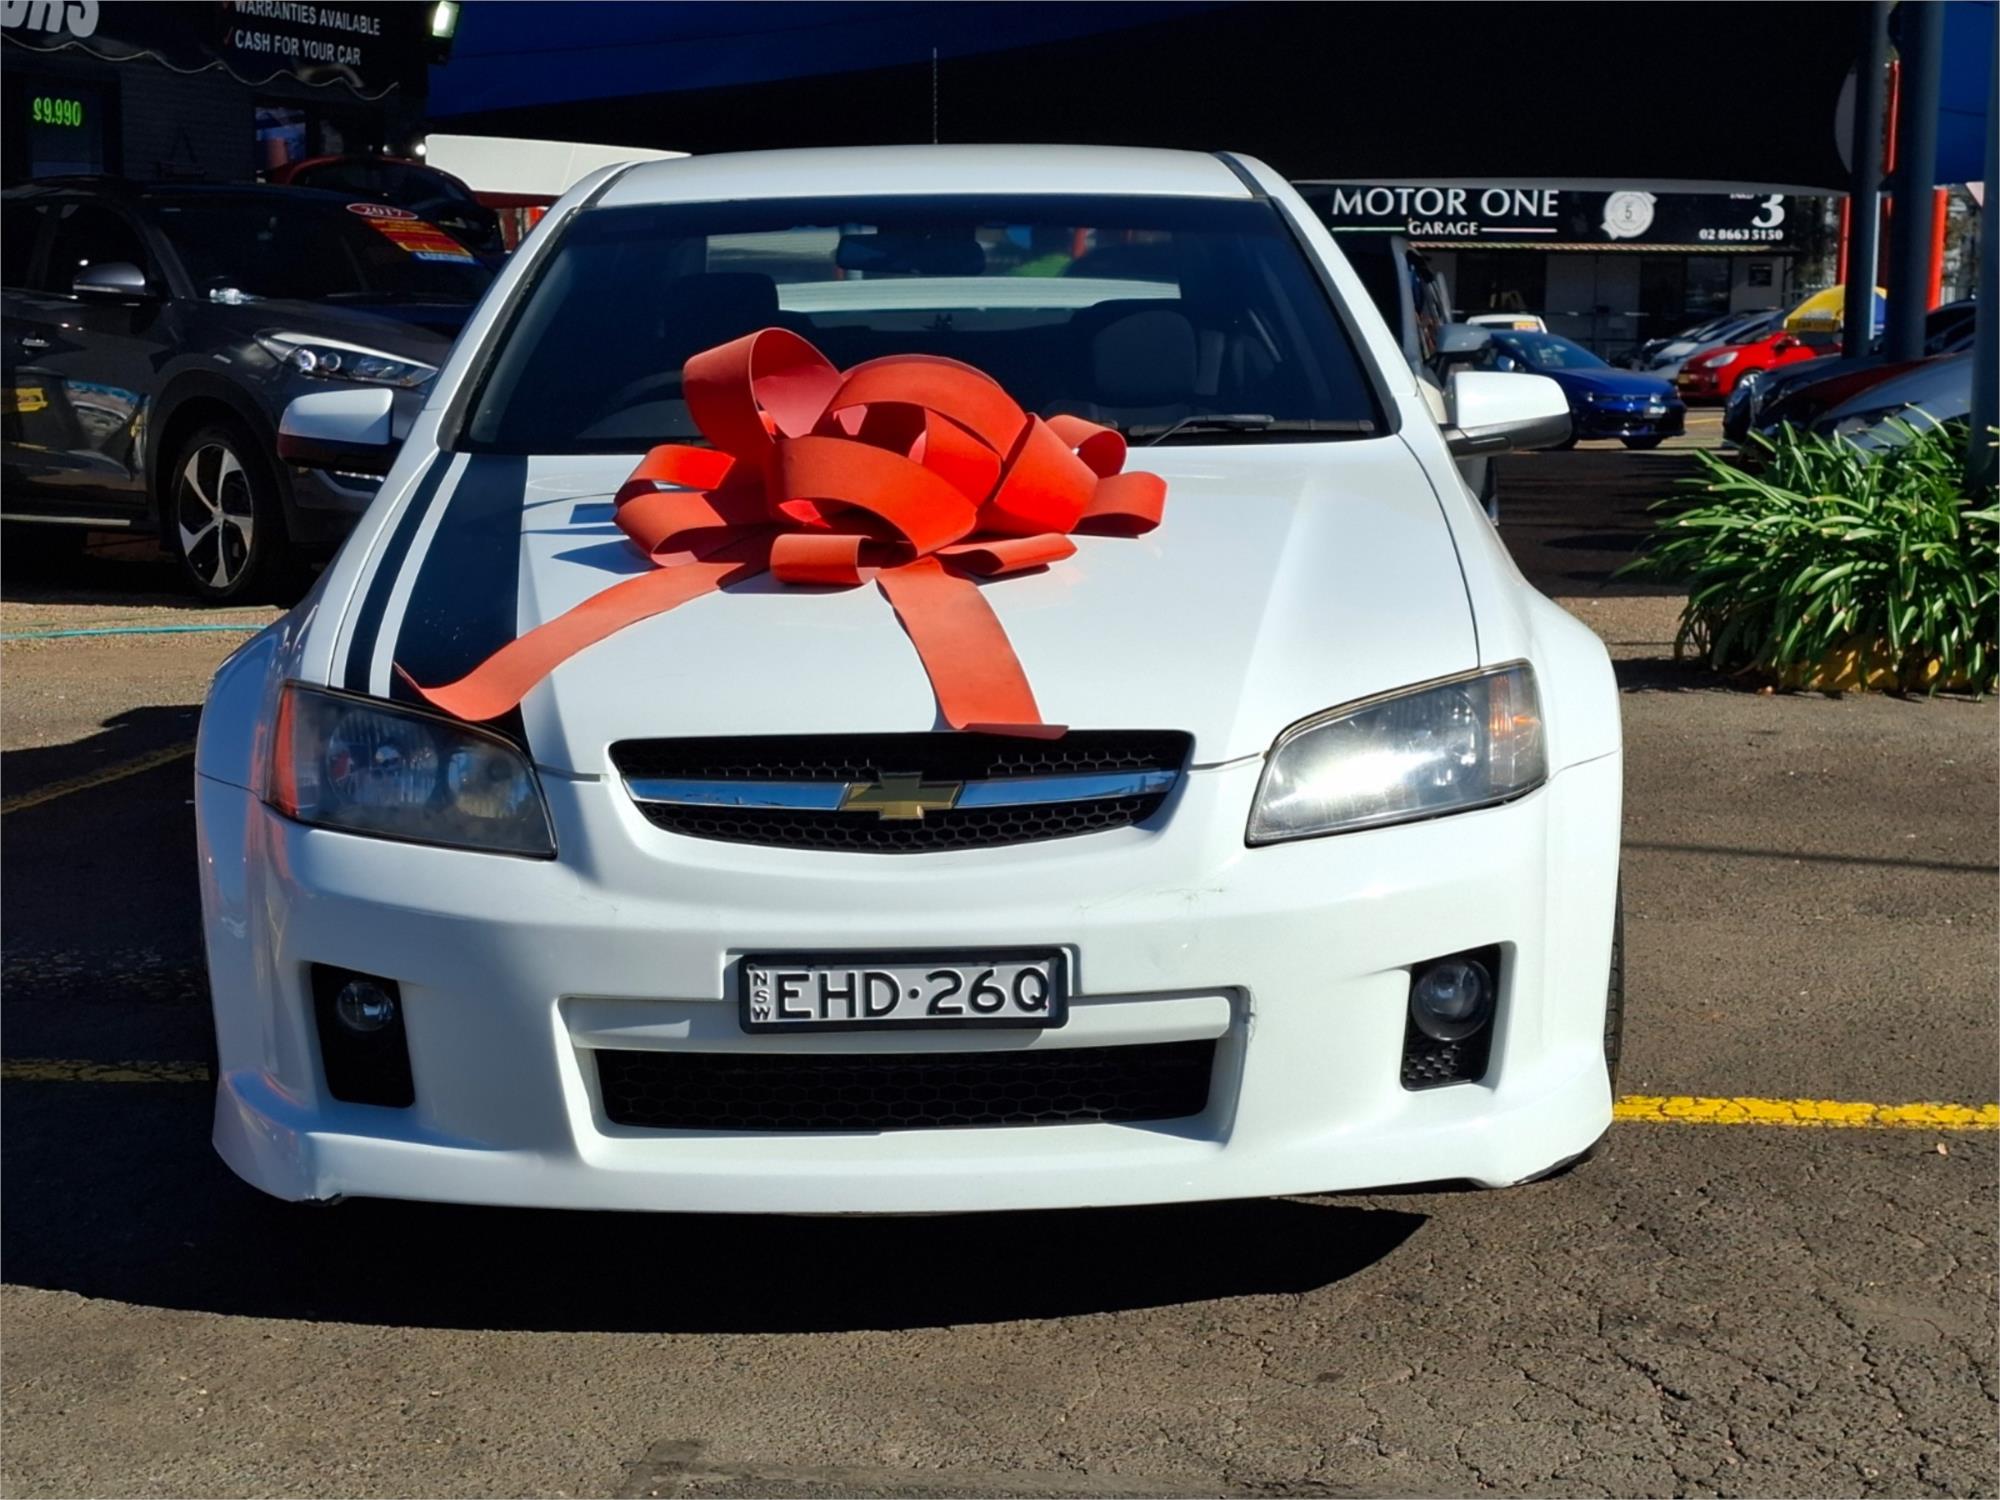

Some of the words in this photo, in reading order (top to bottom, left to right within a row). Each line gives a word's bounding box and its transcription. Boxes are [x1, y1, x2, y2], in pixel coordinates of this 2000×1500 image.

[235, 0, 316, 24] WARRANTIES
[319, 8, 381, 36] AVAILABLE
[235, 29, 271, 52] CASH
[274, 36, 300, 56] FOR
[302, 39, 335, 62] YOUR
[337, 45, 361, 65] CAR
[1332, 188, 1467, 216] MOTOR
[1480, 188, 1559, 217] ONE
[1751, 193, 1785, 228] 3
[1408, 221, 1478, 236] GARAGE
[1699, 228, 1716, 240] 02
[1752, 229, 1784, 240] 5150
